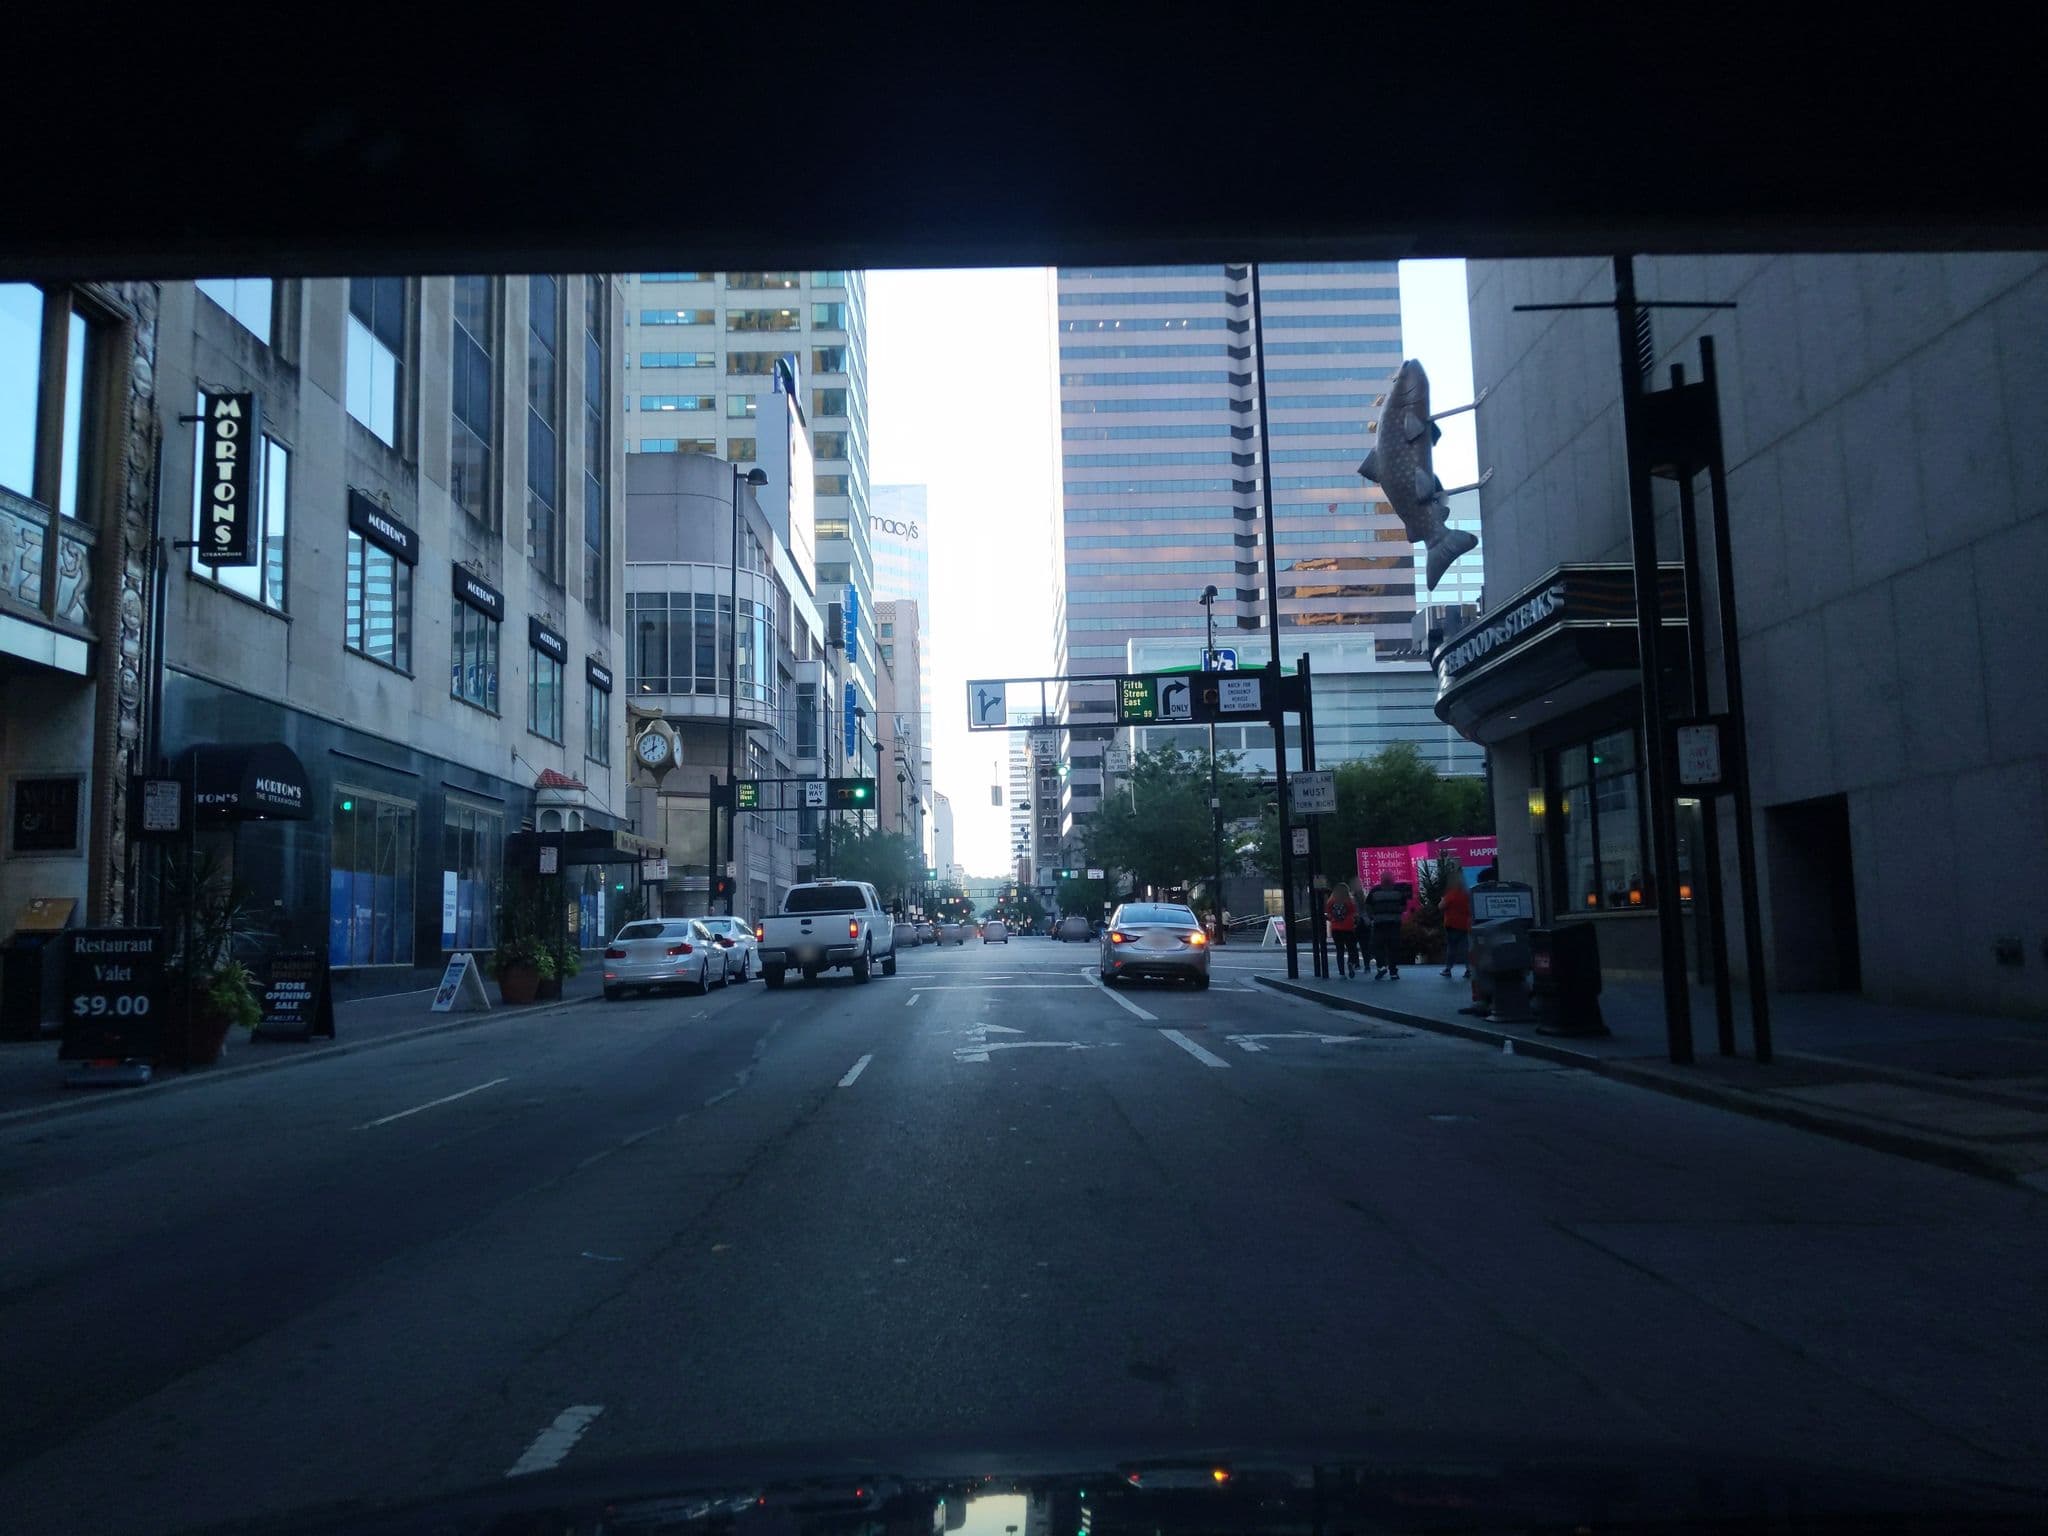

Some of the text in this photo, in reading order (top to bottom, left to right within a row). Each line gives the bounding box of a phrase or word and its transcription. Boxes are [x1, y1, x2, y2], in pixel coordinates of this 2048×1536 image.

[368, 512, 407, 547] MORTON'S
[869, 515, 919, 541] macy's
[467, 580, 496, 606] MORTON'S
[1505, 583, 1566, 640] STEAKS
[1123, 681, 1143, 689] Fifth
[1123, 690, 1148, 698] Street
[1123, 698, 1142, 706] East
[1171, 704, 1189, 712] ONLY
[256, 778, 302, 799] MORTON'S
[1303, 788, 1326, 796] MUST
[256, 792, 266, 800] THE
[74, 936, 153, 952] Restaurant
[94, 964, 132, 981] Valet
[274, 982, 306, 990] STORE
[265, 992, 312, 1000] OPENING
[72, 994, 150, 1016] $9.00
[274, 1001, 300, 1009] SALE
